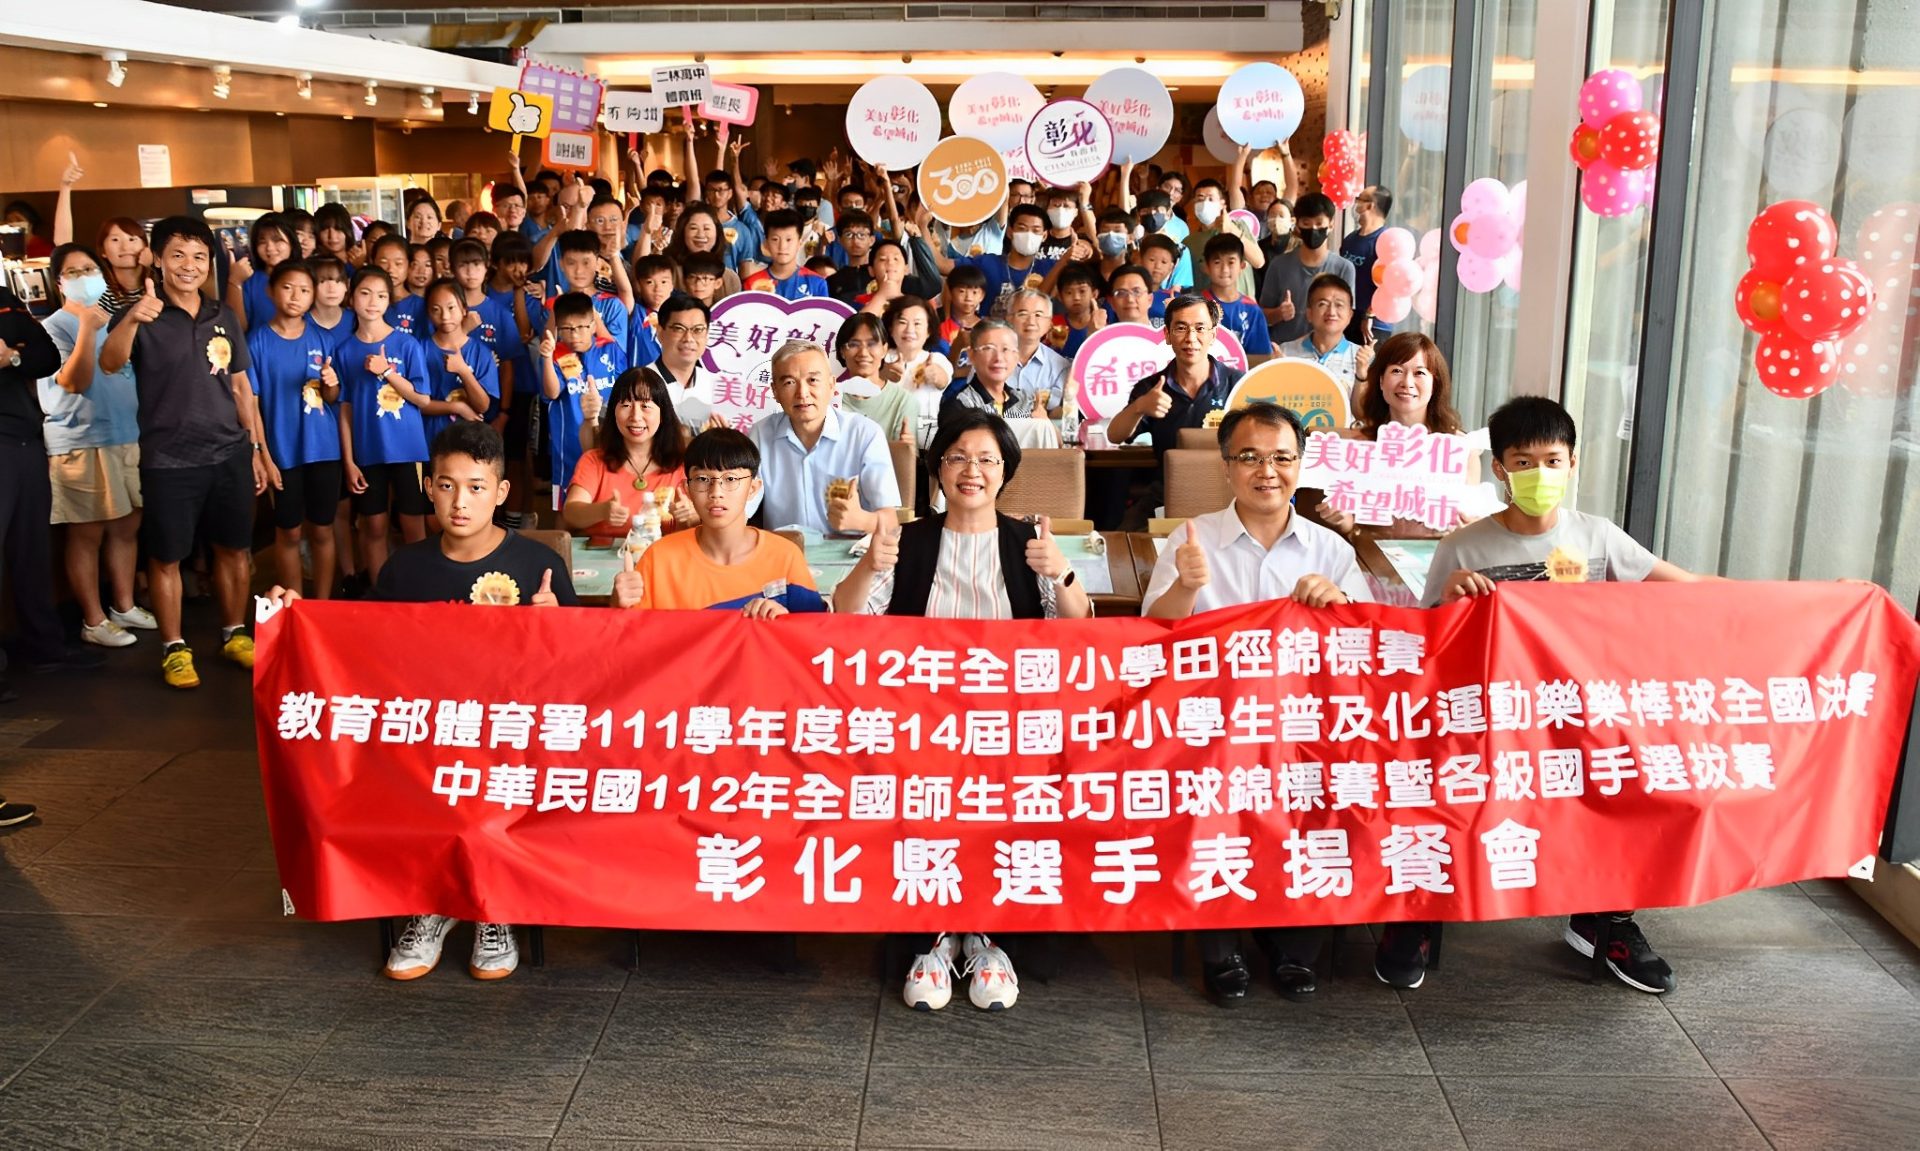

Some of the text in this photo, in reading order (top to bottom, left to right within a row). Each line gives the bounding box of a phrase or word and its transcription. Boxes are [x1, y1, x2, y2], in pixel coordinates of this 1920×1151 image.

[1044, 110, 1096, 147] 彰化
[1086, 355, 1239, 397] 希望
[1305, 425, 1464, 475] 美好彰化
[1329, 479, 1460, 528] 希望城市
[811, 628, 1426, 693] 112年全國小學田徑錦標賽
[695, 819, 1541, 907] 彰化縣選手表揚餐會
